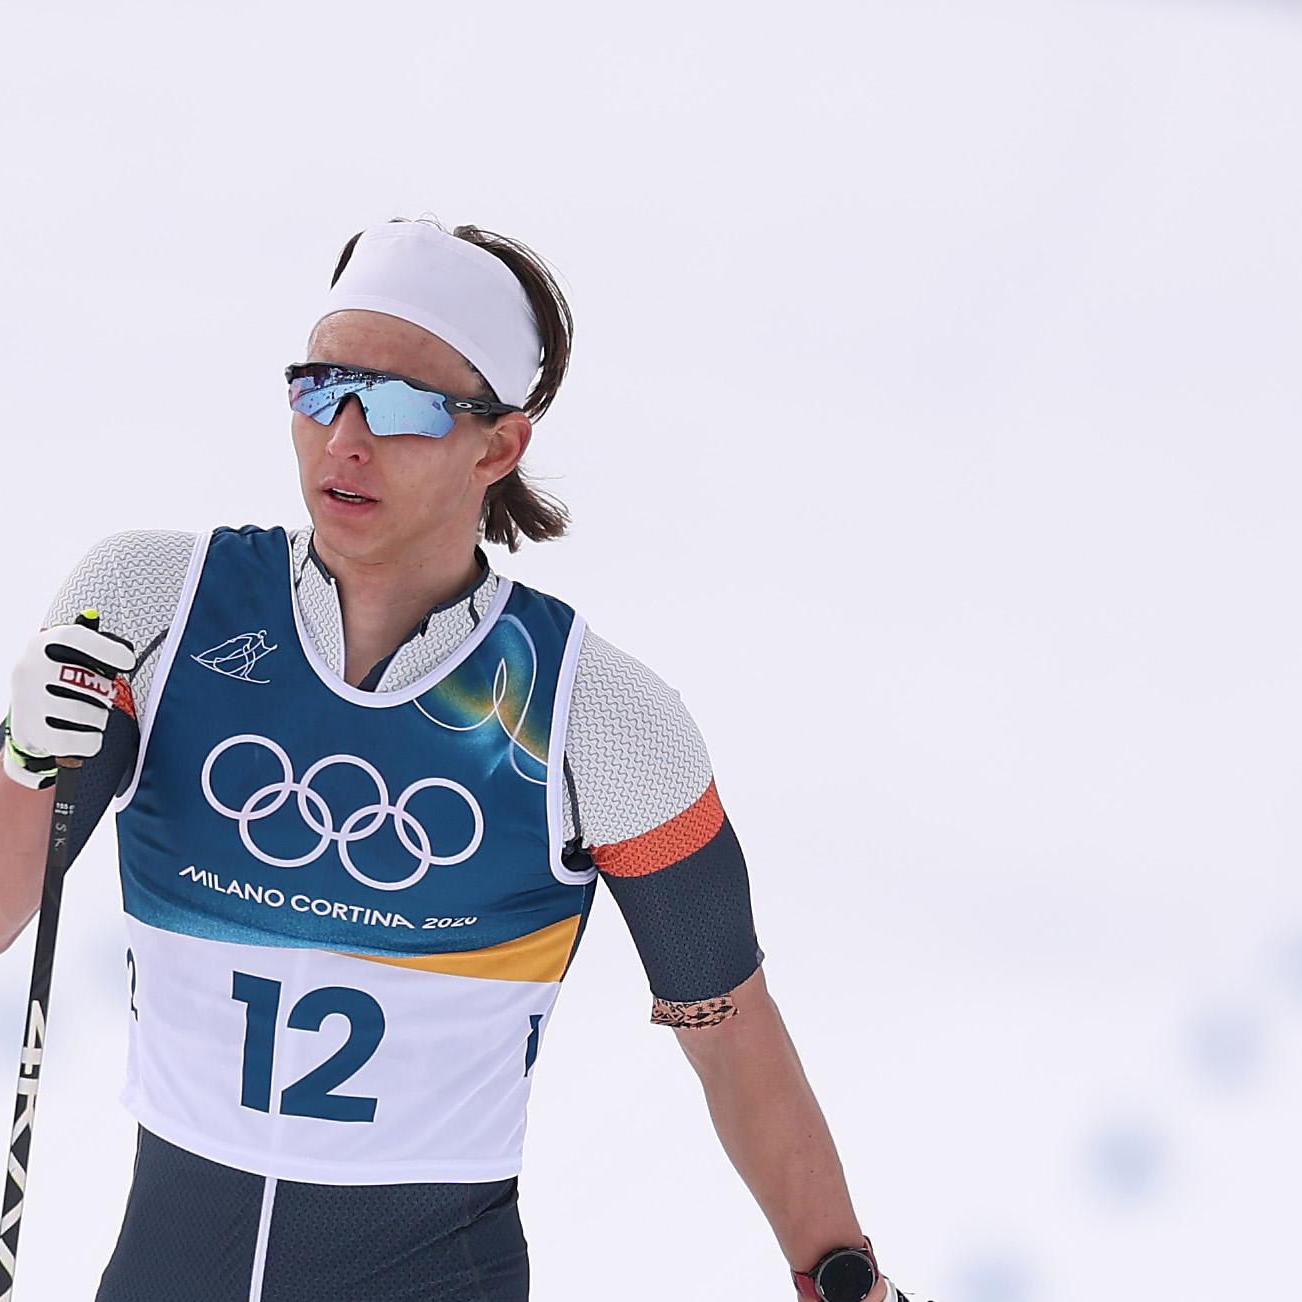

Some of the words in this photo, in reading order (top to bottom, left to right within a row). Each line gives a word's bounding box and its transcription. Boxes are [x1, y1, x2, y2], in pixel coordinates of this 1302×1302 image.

[179, 865, 285, 908] MILANO
[290, 894, 415, 929] CORTINA
[231, 970, 387, 1123] 12
